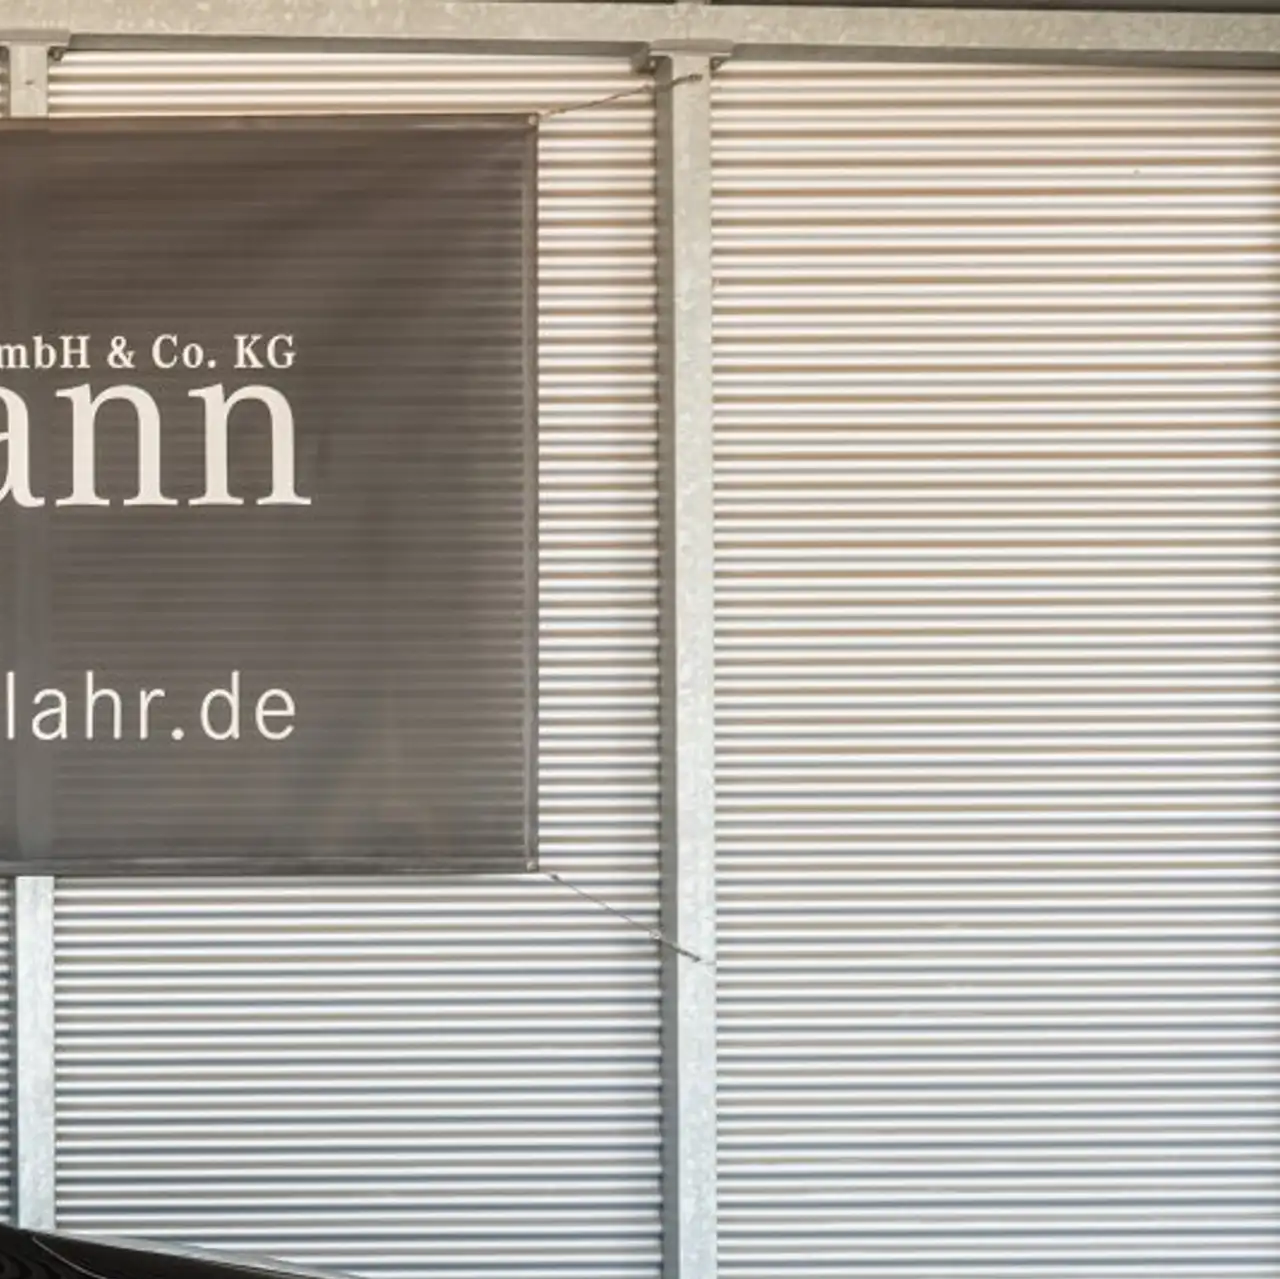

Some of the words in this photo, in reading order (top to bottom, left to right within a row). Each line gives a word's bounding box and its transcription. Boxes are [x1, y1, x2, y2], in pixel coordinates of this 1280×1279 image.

[106, 335, 136, 369] &
[152, 334, 217, 369] Co.
[234, 334, 297, 369] KG
